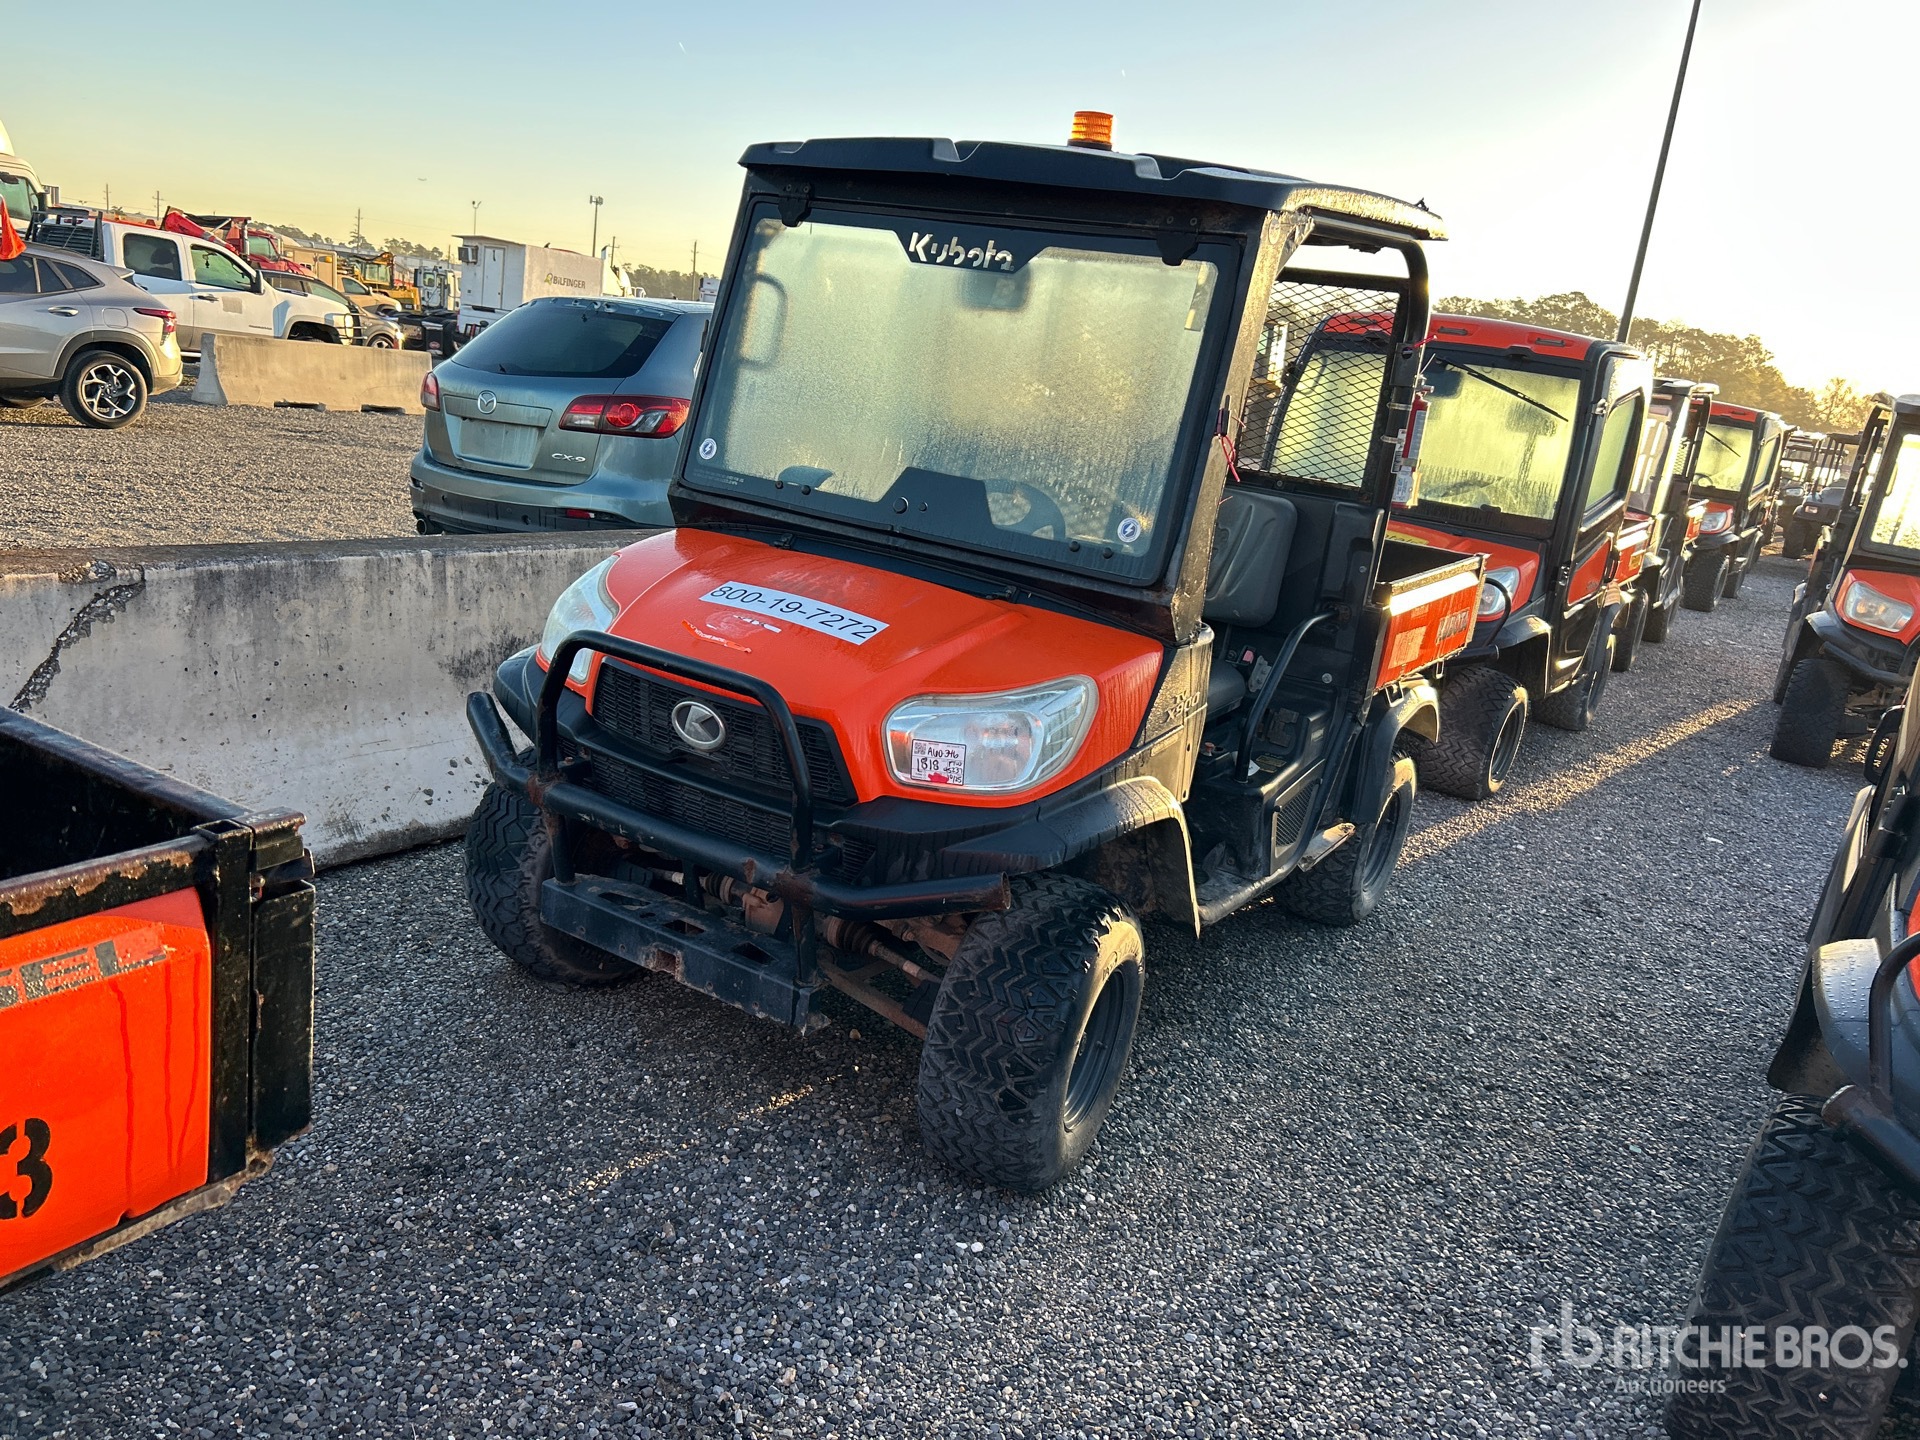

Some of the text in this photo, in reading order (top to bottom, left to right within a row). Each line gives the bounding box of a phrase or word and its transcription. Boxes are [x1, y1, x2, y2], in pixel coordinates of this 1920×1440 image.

[908, 231, 1013, 271] Kubota
[551, 452, 587, 463] CX-9
[710, 585, 878, 639] 800-19-7272
[0, 939, 168, 1010] EL
